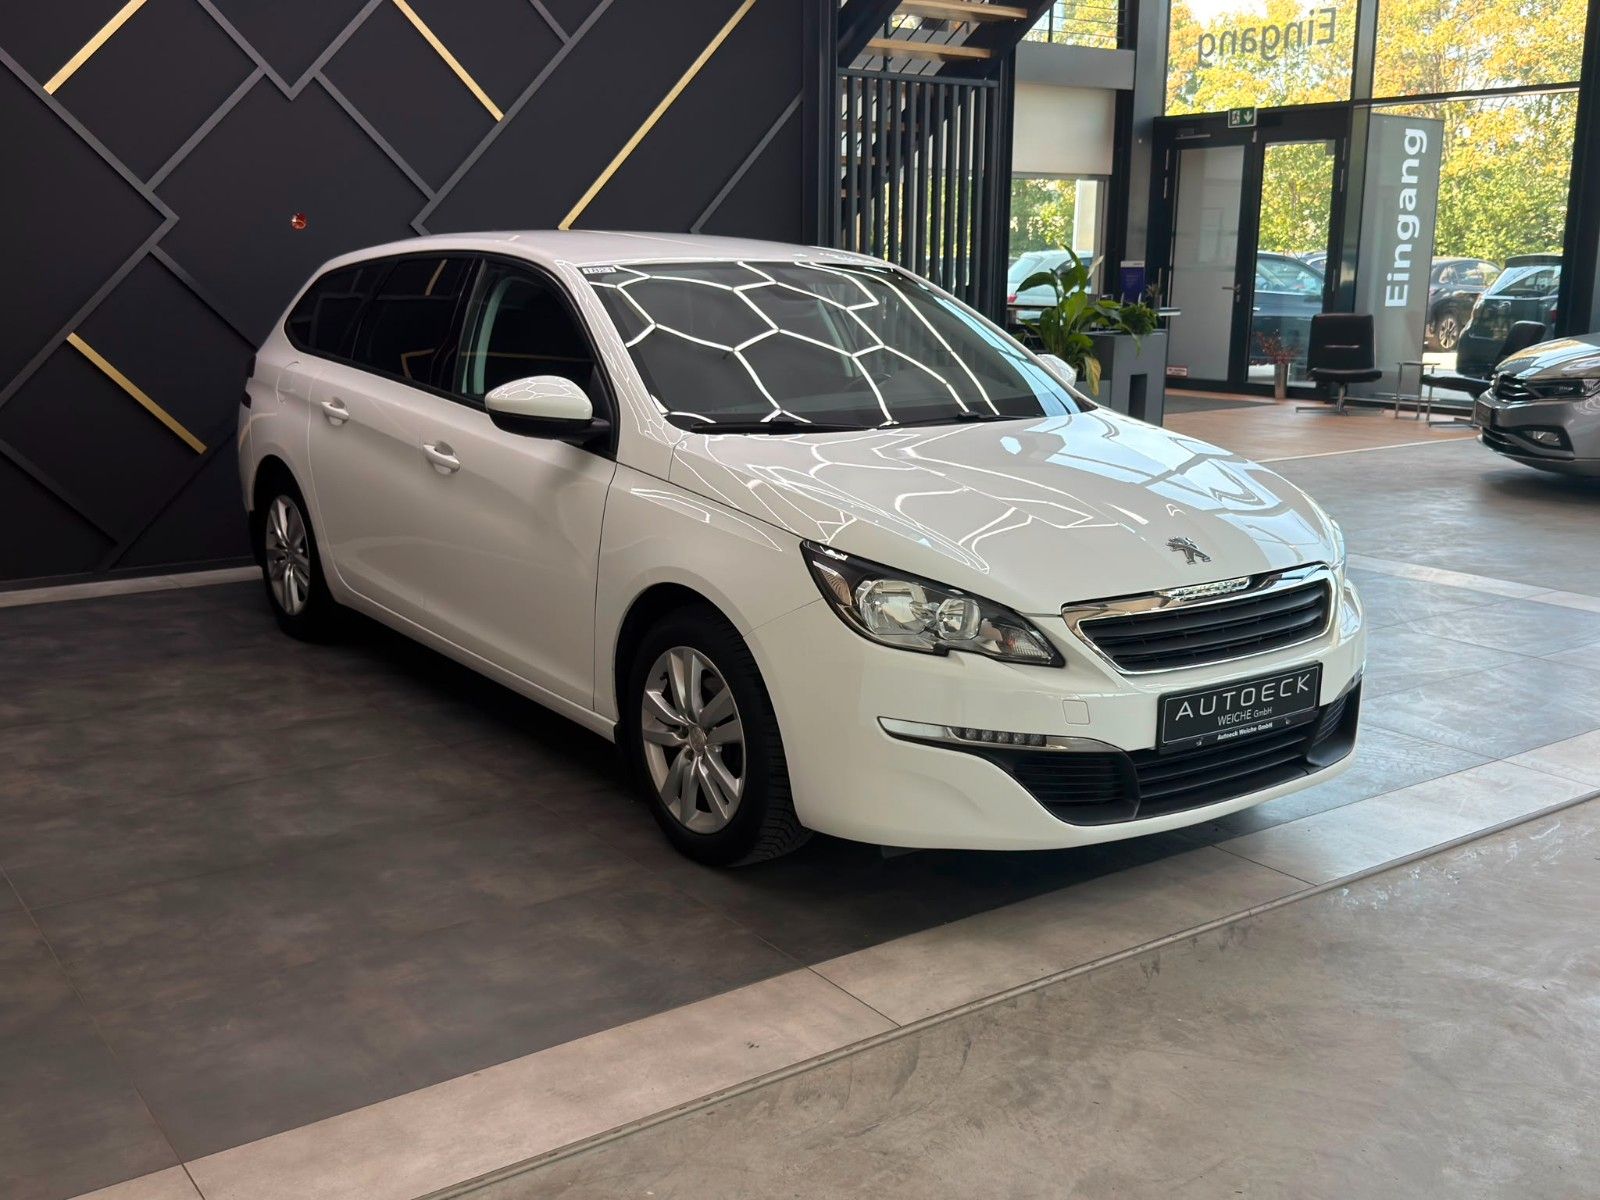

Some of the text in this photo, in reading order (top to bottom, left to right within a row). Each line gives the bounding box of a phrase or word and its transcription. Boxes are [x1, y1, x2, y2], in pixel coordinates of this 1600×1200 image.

[1385, 128, 1427, 307] Eingang
[1175, 674, 1310, 721] AUTOECK
[1217, 706, 1273, 726] WEICHE GmbH
